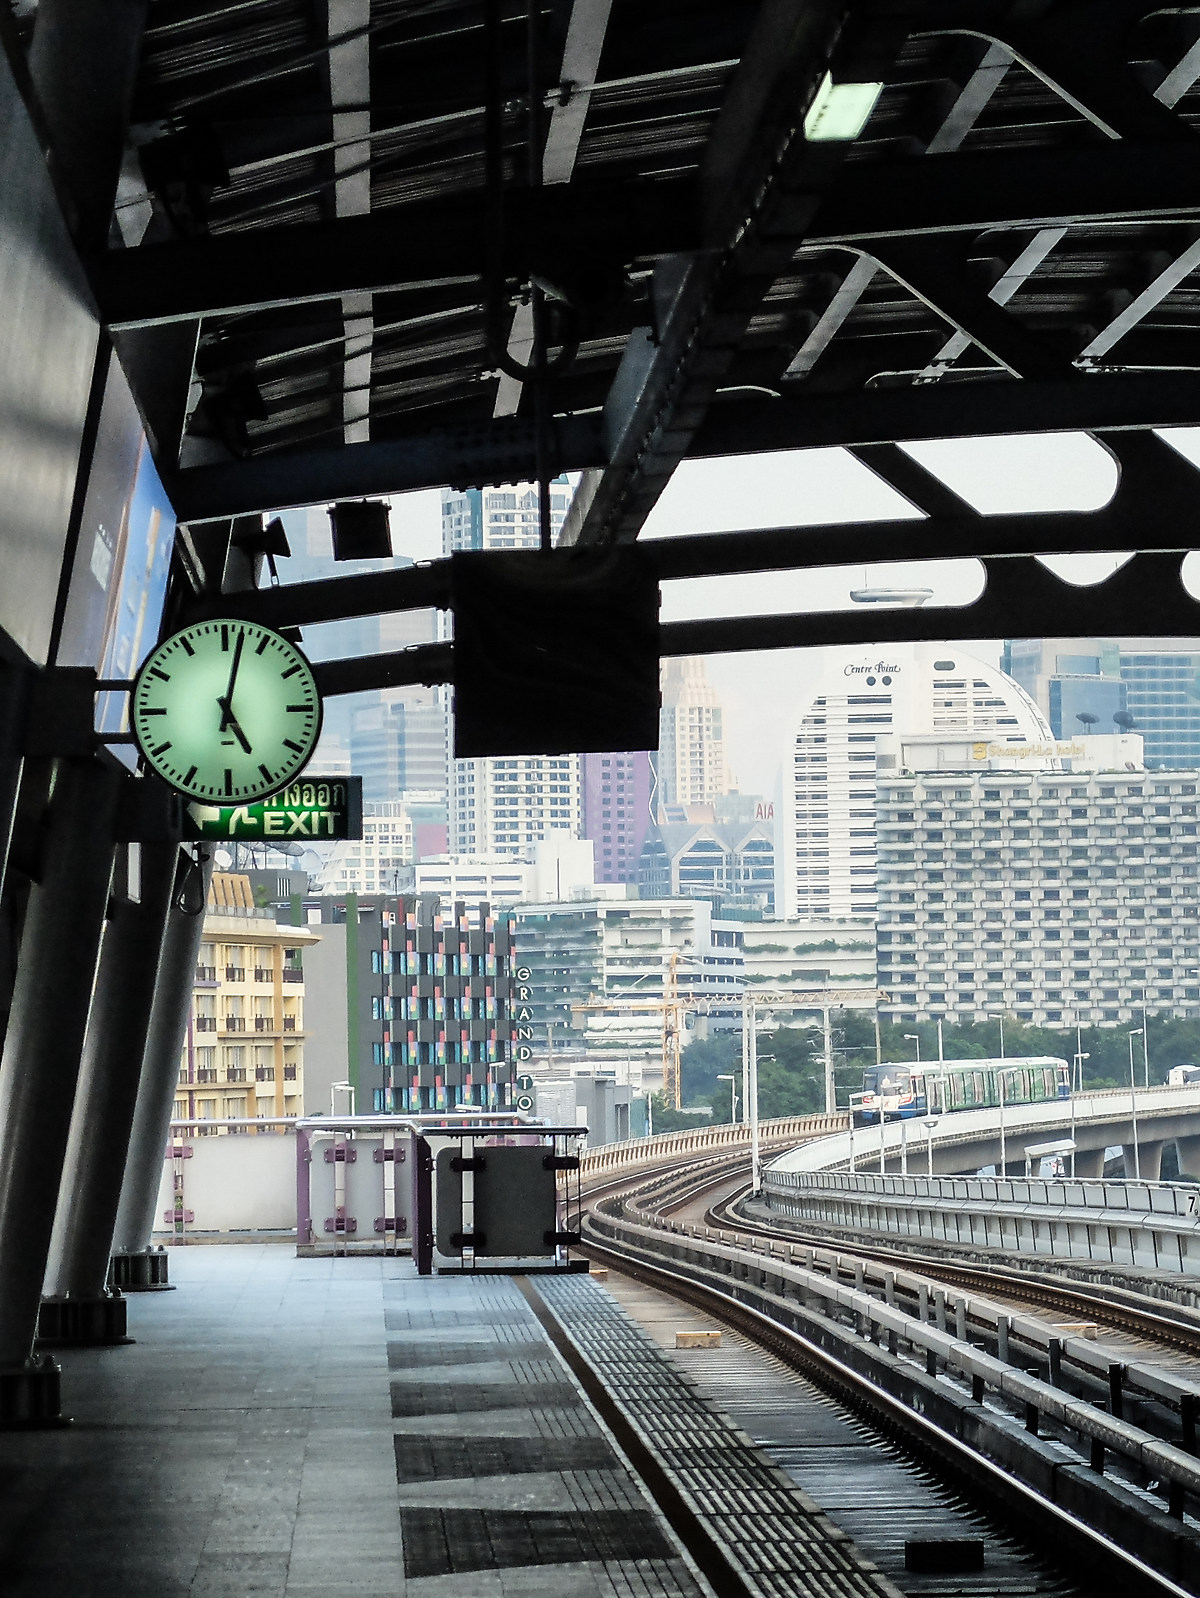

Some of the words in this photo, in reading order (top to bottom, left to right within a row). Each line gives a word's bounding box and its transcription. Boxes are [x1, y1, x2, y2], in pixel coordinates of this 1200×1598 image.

[843, 664, 872, 676] Centre
[874, 660, 901, 673] Point
[755, 802, 774, 820] AIA
[263, 811, 341, 835] EXIT
[517, 967, 532, 1061] GRAND
[1188, 1196, 1196, 1213] 7
